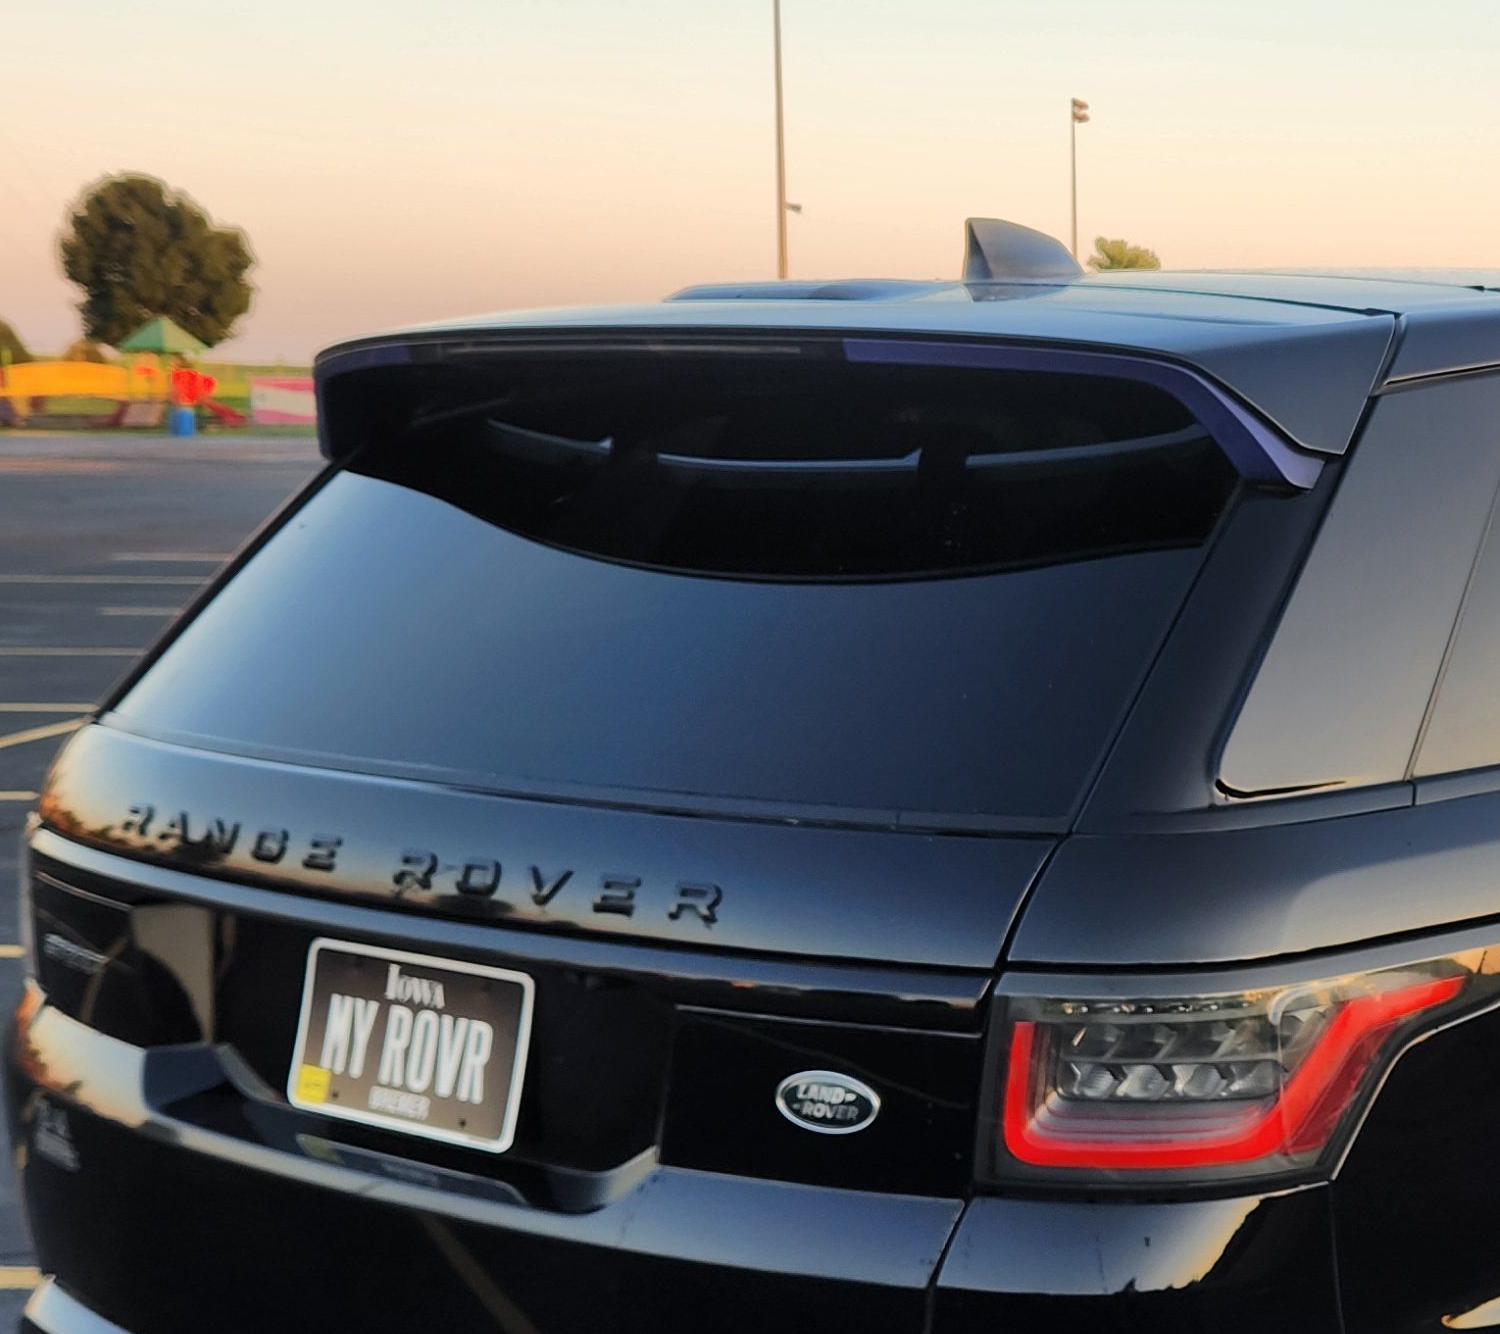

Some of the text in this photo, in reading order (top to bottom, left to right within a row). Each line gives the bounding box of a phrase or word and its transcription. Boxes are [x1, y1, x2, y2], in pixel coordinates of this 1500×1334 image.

[121, 804, 724, 926] RANGE ROVER
[378, 1004, 494, 1105] ROVR
